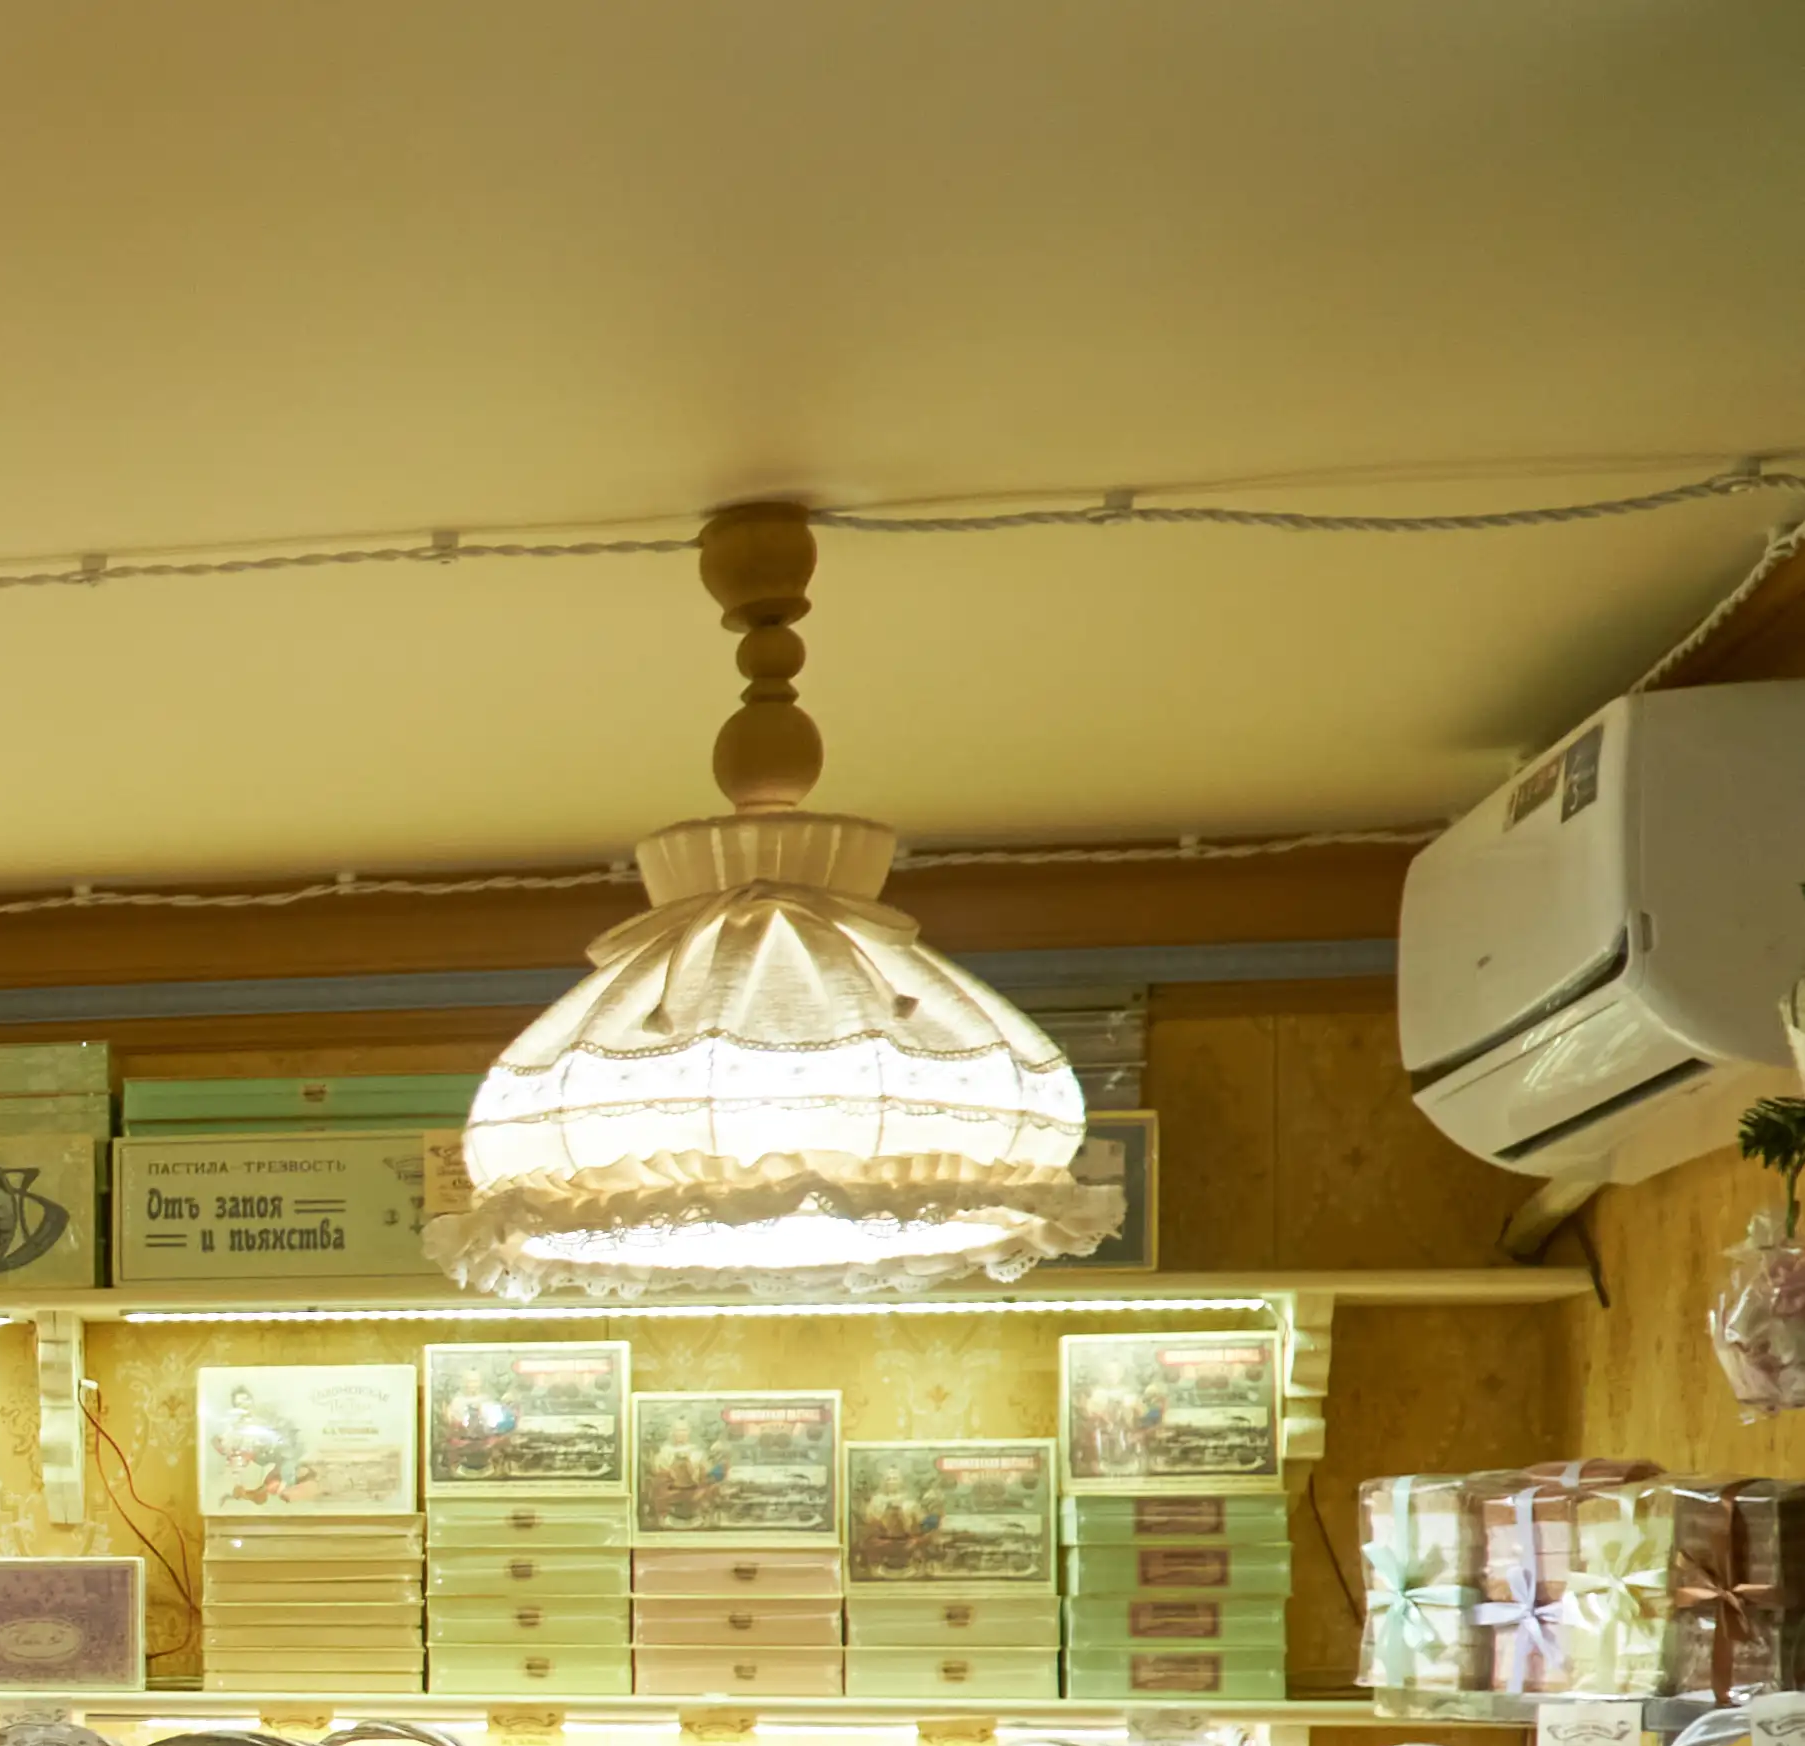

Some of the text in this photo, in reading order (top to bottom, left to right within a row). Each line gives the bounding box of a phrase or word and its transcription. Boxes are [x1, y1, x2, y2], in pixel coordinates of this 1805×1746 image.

[147, 1158, 347, 1176] ПАСТИЛА ТРЕЗВОСТЬ
[214, 1194, 284, 1220] запоя
[200, 1217, 346, 1253] и пьянства
